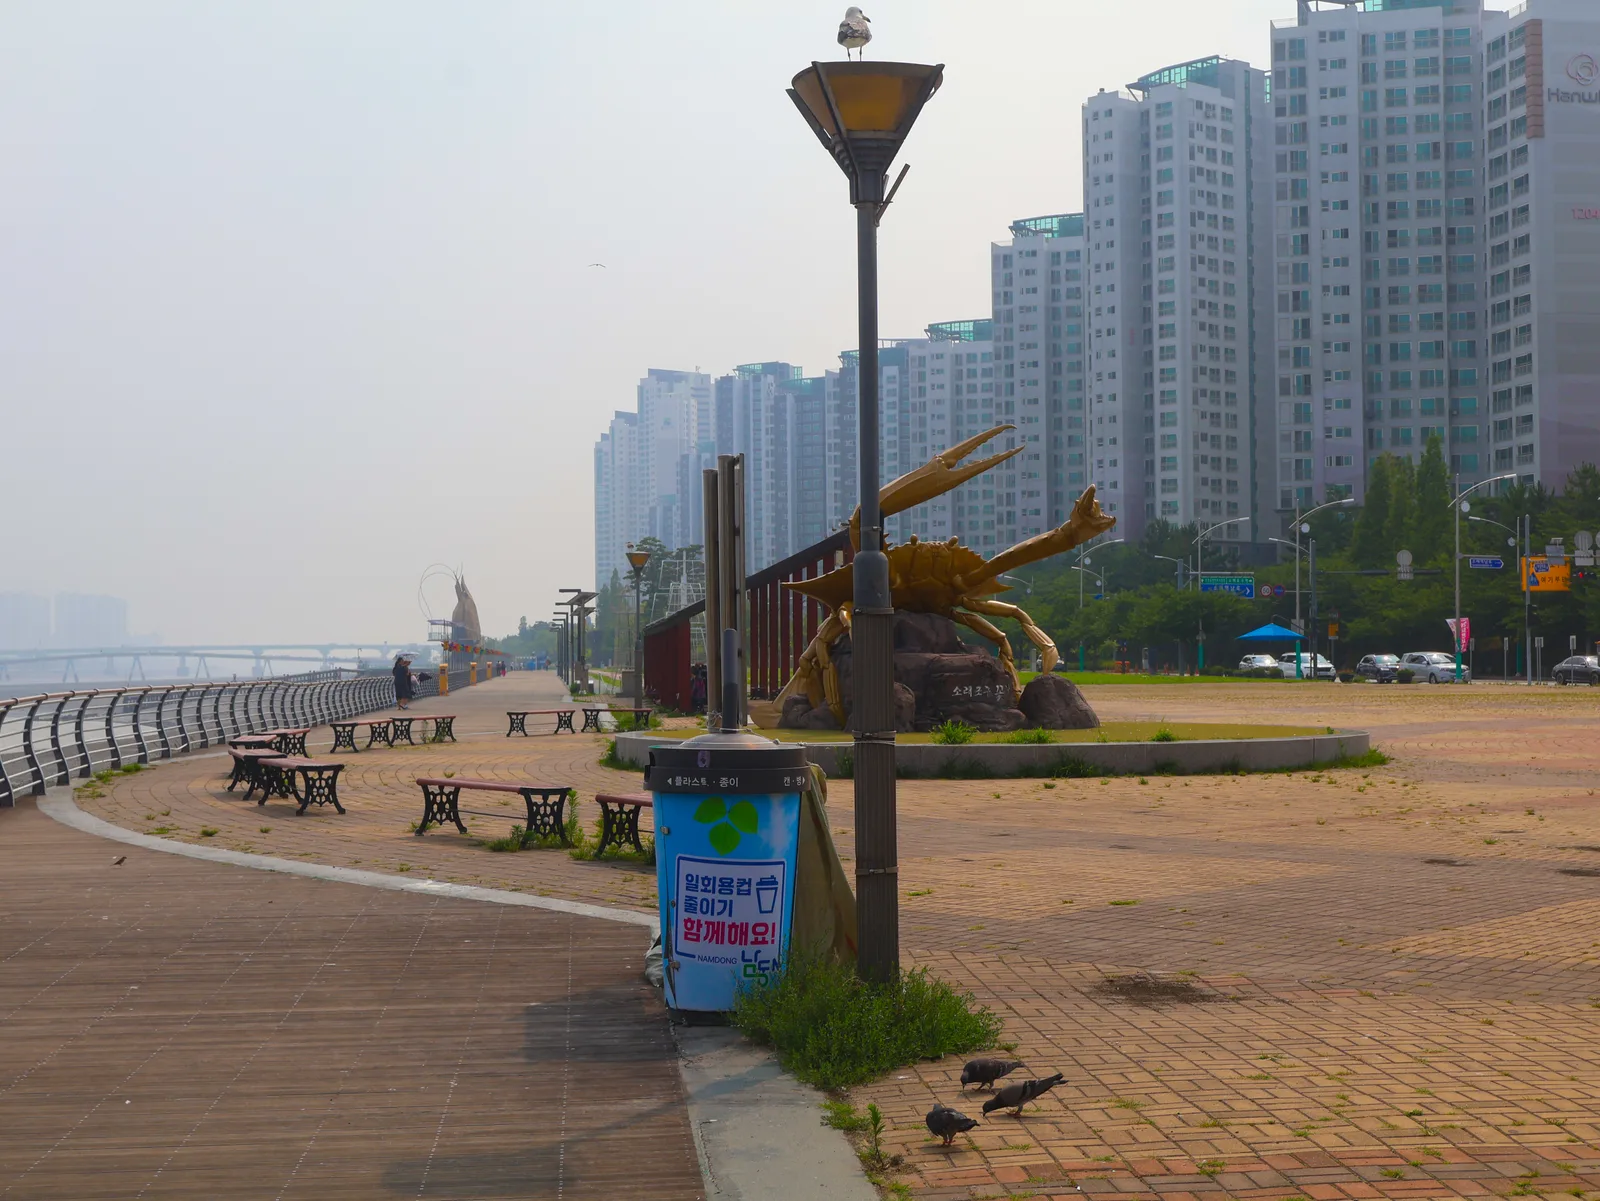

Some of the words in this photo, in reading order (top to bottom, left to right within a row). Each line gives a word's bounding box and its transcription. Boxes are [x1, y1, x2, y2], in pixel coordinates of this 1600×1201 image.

[1547, 87, 1600, 103] Hanw
[718, 776, 739, 788] 종이
[684, 872, 753, 896] 일회용컵
[683, 896, 734, 918] 줄이기
[683, 917, 776, 946] 함께해요!
[697, 953, 738, 965] NAMDONG
